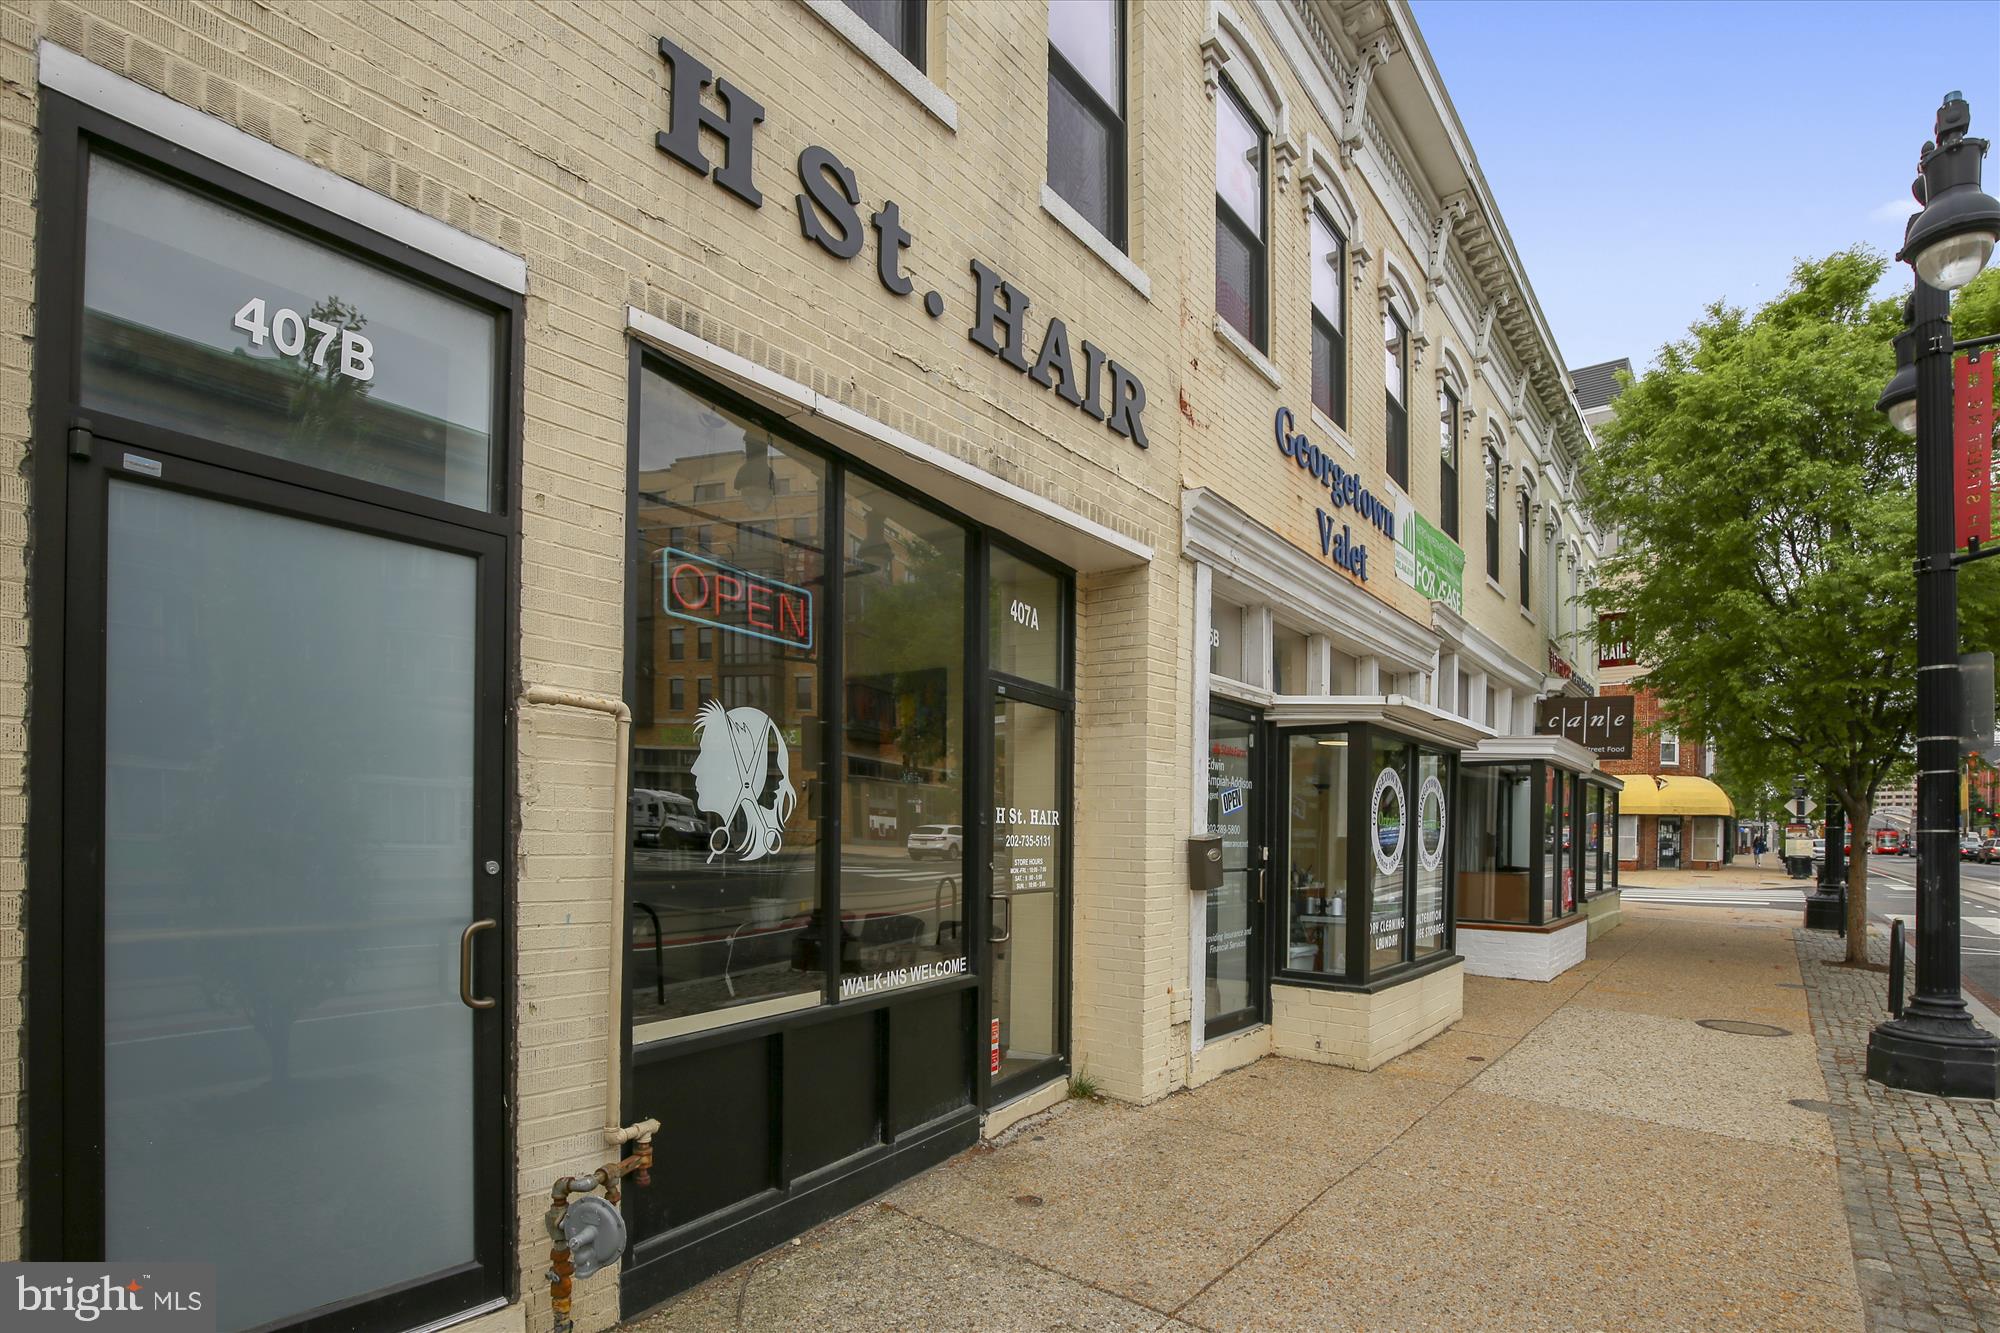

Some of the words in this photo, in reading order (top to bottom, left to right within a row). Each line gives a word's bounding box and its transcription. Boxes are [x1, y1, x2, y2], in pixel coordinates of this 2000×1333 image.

[655, 36, 765, 209] H
[796, 145, 944, 318] St.
[968, 258, 1149, 449] HAIR
[234, 297, 375, 381] 407B
[1275, 406, 1395, 540] Georgetown
[1316, 507, 1369, 582] Valet
[1416, 560, 1436, 598] FOR
[671, 563, 805, 637] OPEN
[1010, 600, 1039, 631] 407A
[995, 807, 1006, 824] H
[1009, 808, 1026, 825] St.
[1030, 809, 1060, 826] HAIR
[1223, 788, 1242, 812] OPEN
[1005, 834, 1051, 847] 202-735-5131
[1014, 858, 1028, 866] STORE
[1375, 934, 1398, 950] LAUNDRY
[842, 968, 907, 996] WALK-INS
[910, 956, 967, 982] WELCOME
